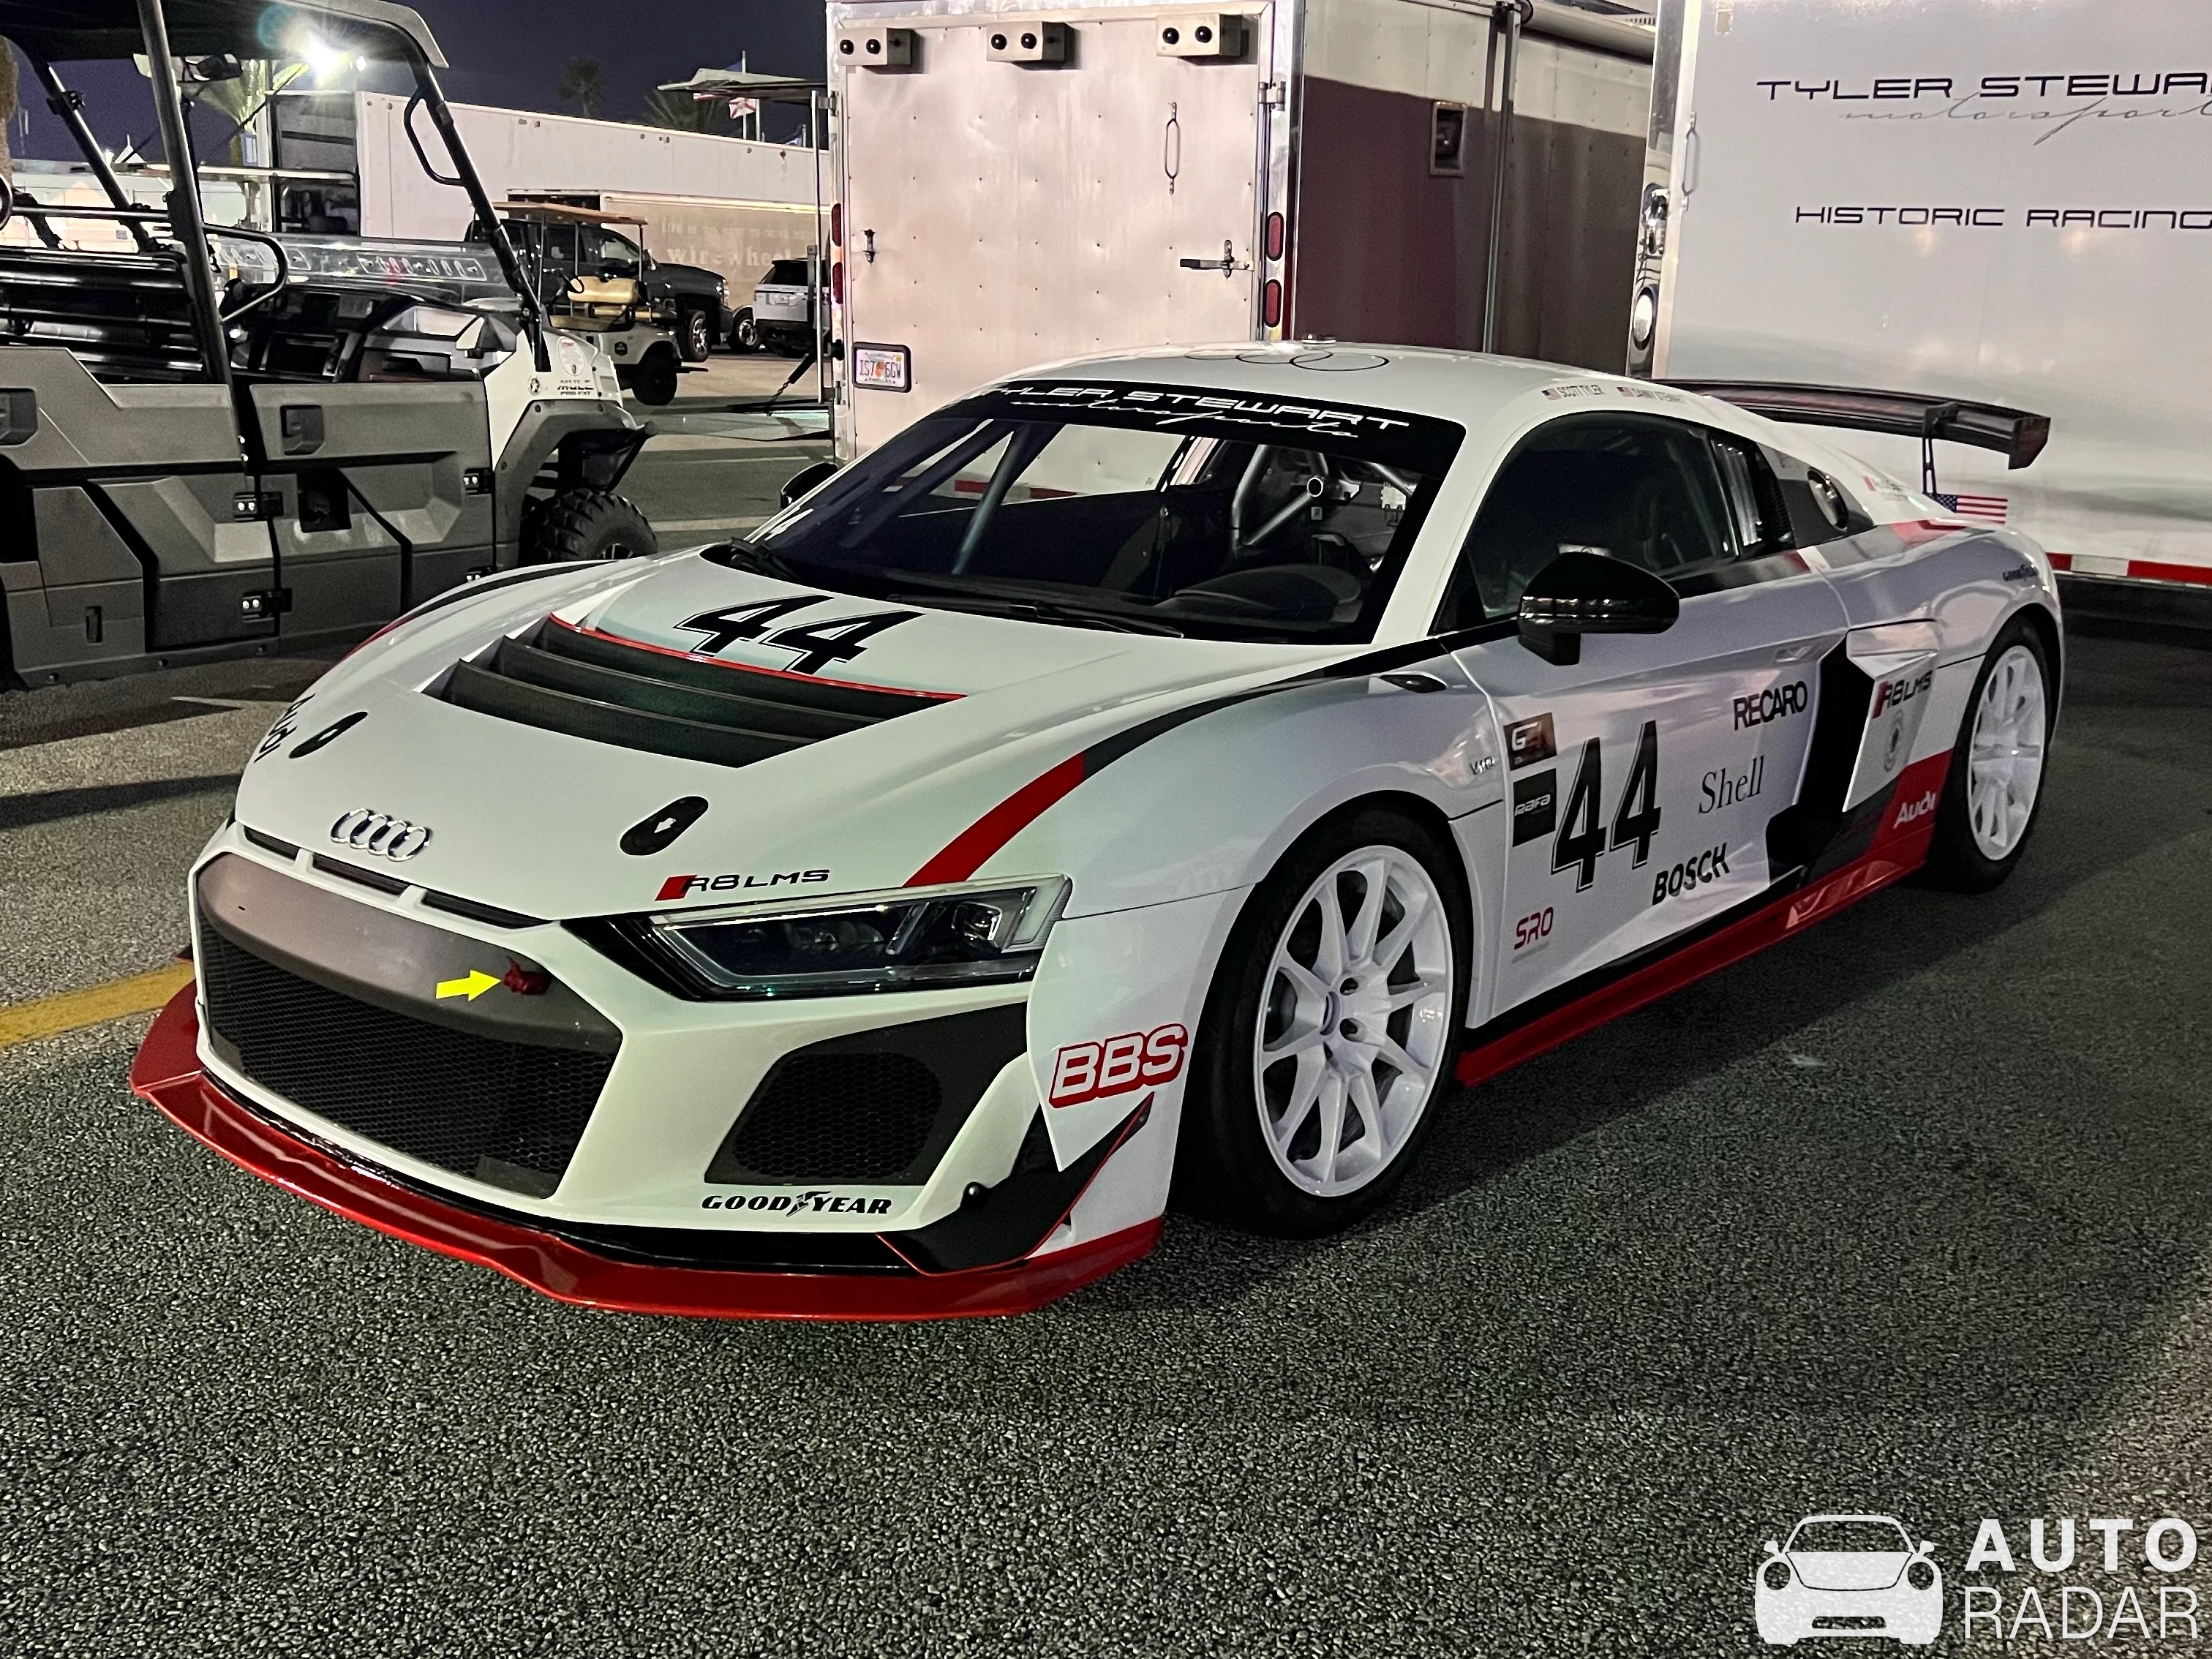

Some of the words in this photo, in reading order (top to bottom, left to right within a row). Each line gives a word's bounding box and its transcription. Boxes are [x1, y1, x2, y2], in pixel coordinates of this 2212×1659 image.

[1756, 78, 1953, 101] TYLER
[1979, 72, 2212, 98] STEWA
[1794, 206, 2005, 227] HISTORIC
[2025, 209, 2212, 230] RACING
[1123, 391, 1410, 431] STEWART
[672, 593, 926, 675] 44
[1734, 680, 1807, 731] RECARO
[1551, 721, 1661, 893] 44
[1698, 755, 1766, 815] Shell
[1893, 790, 1937, 830] Audi
[1652, 842, 1730, 906] BOSCH
[1513, 906, 1554, 949] SRO
[1048, 1023, 1189, 1109] BBS
